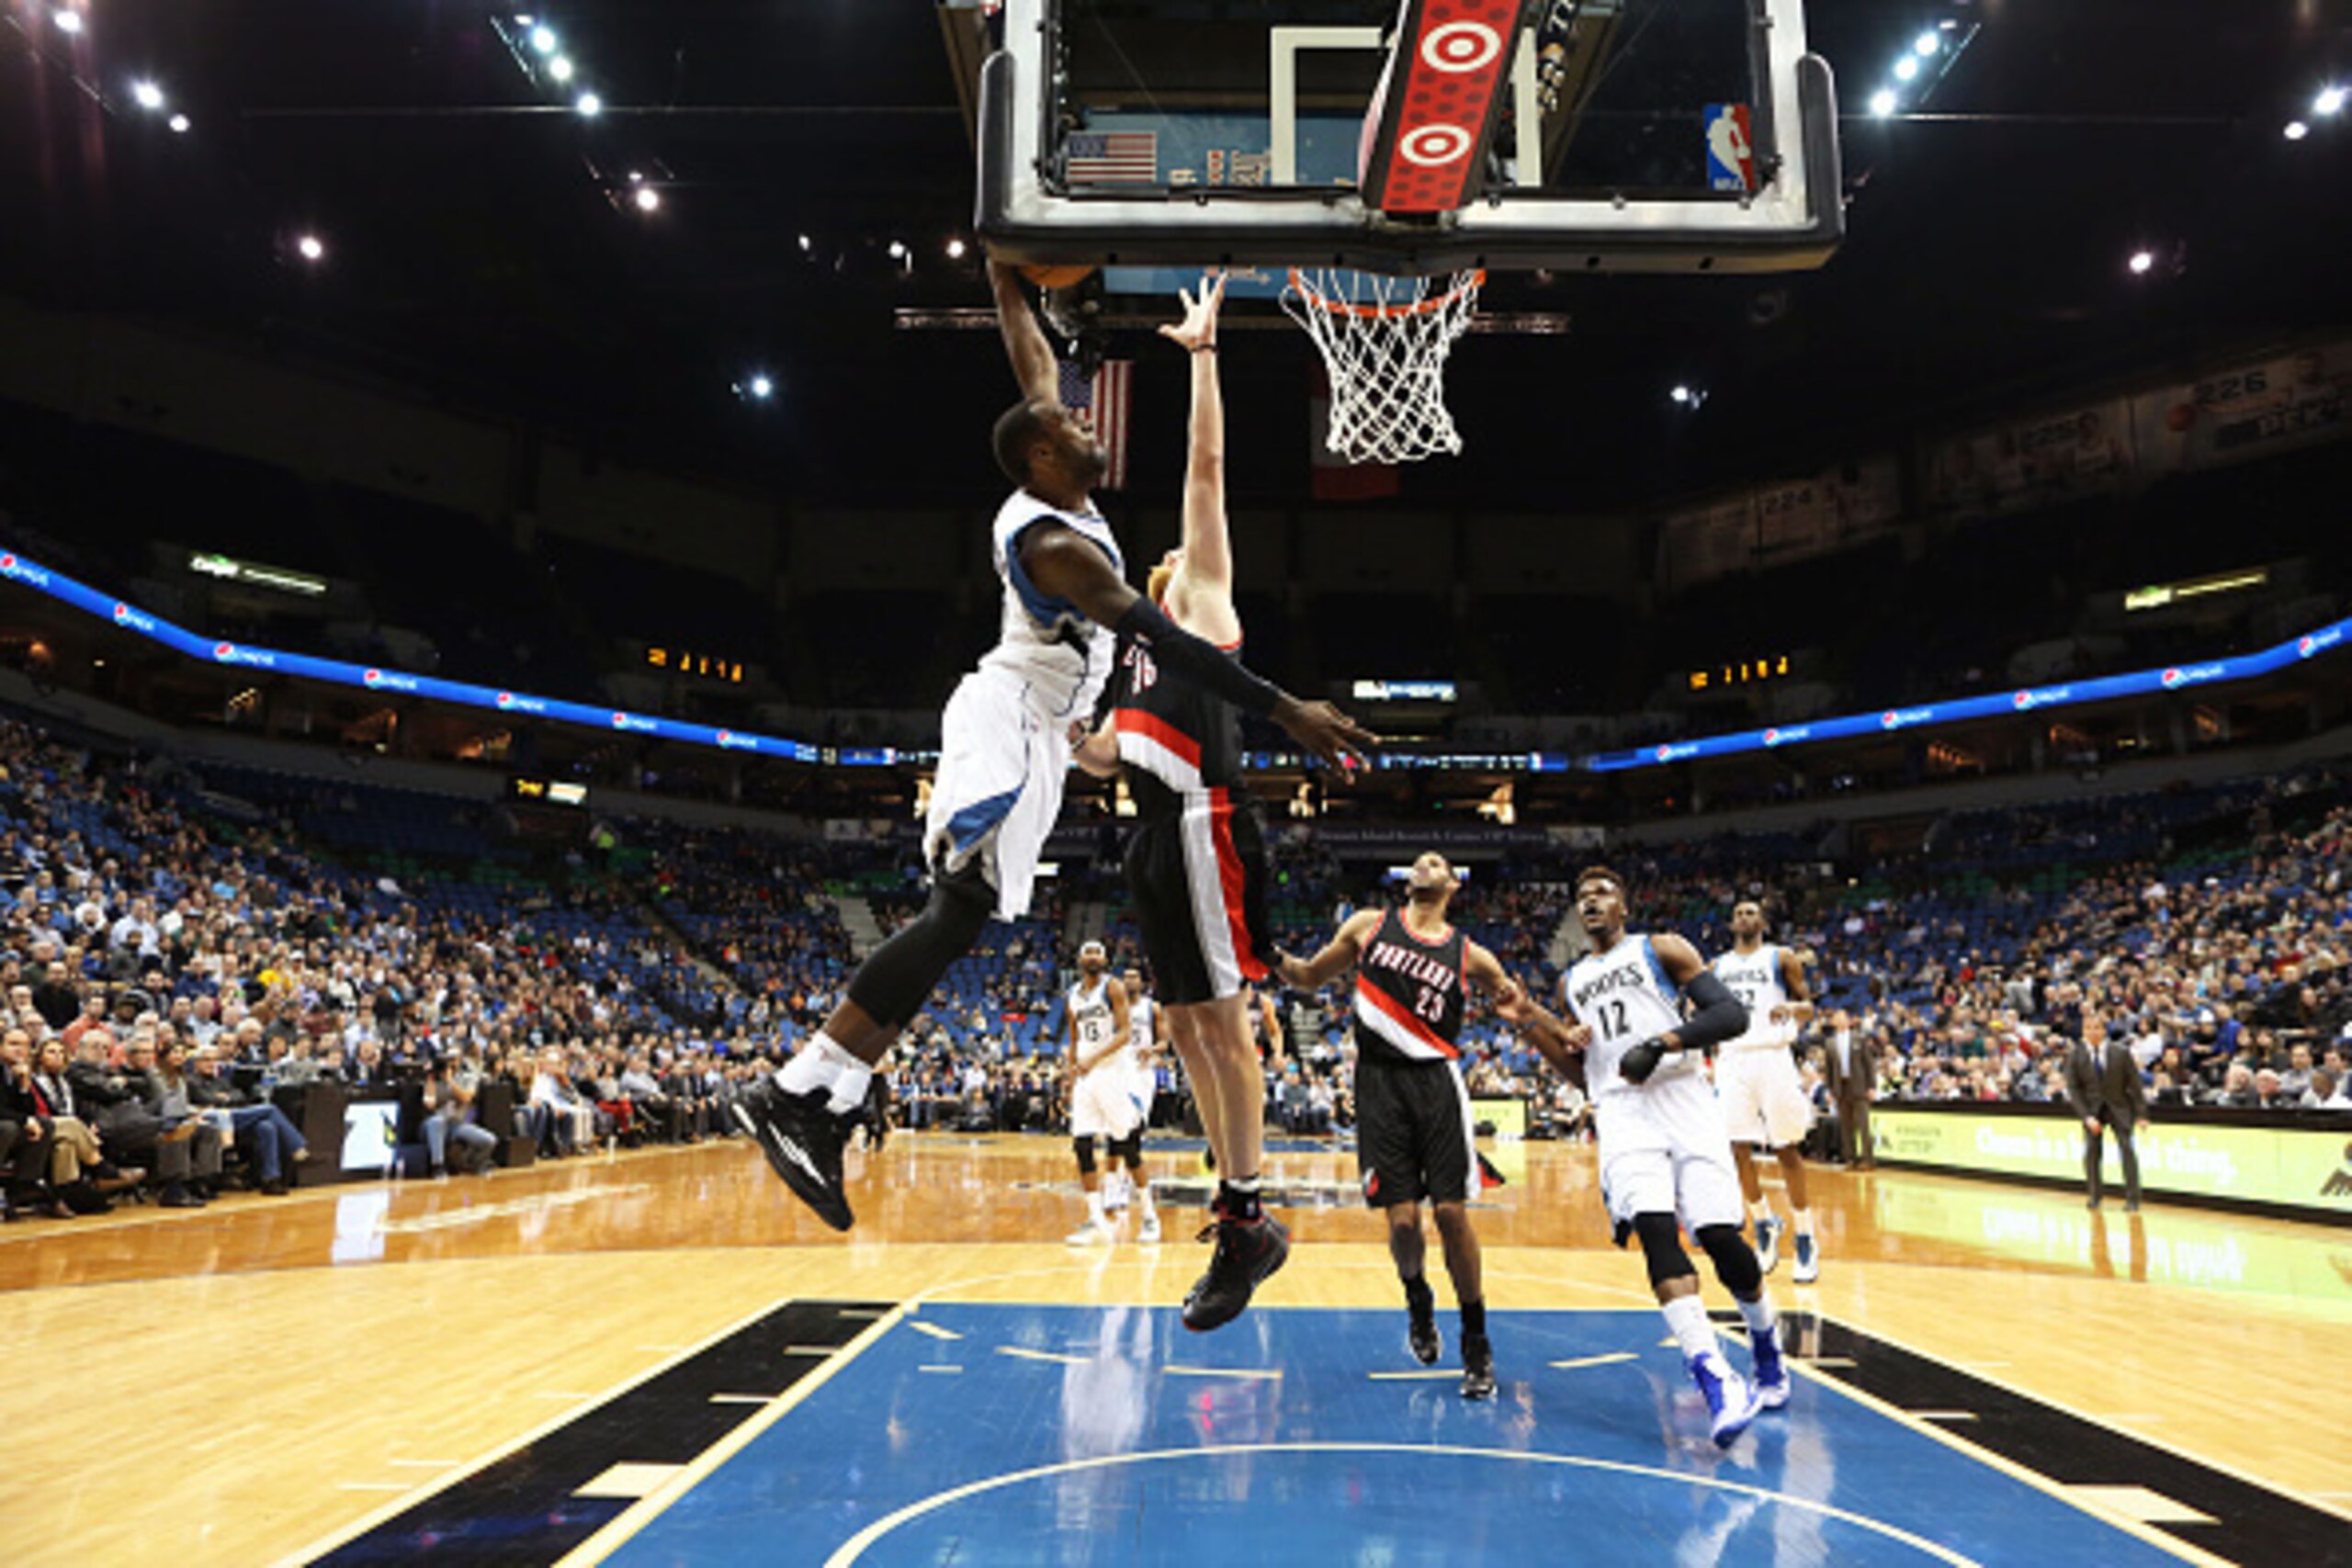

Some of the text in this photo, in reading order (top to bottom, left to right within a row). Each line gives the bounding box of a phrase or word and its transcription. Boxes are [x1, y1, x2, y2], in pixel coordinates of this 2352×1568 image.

[1369, 942, 1455, 992] PORTLAND
[1575, 964, 1644, 1007] WOLVES
[1416, 986, 1445, 1022] 23
[1599, 1000, 1631, 1041] 12
